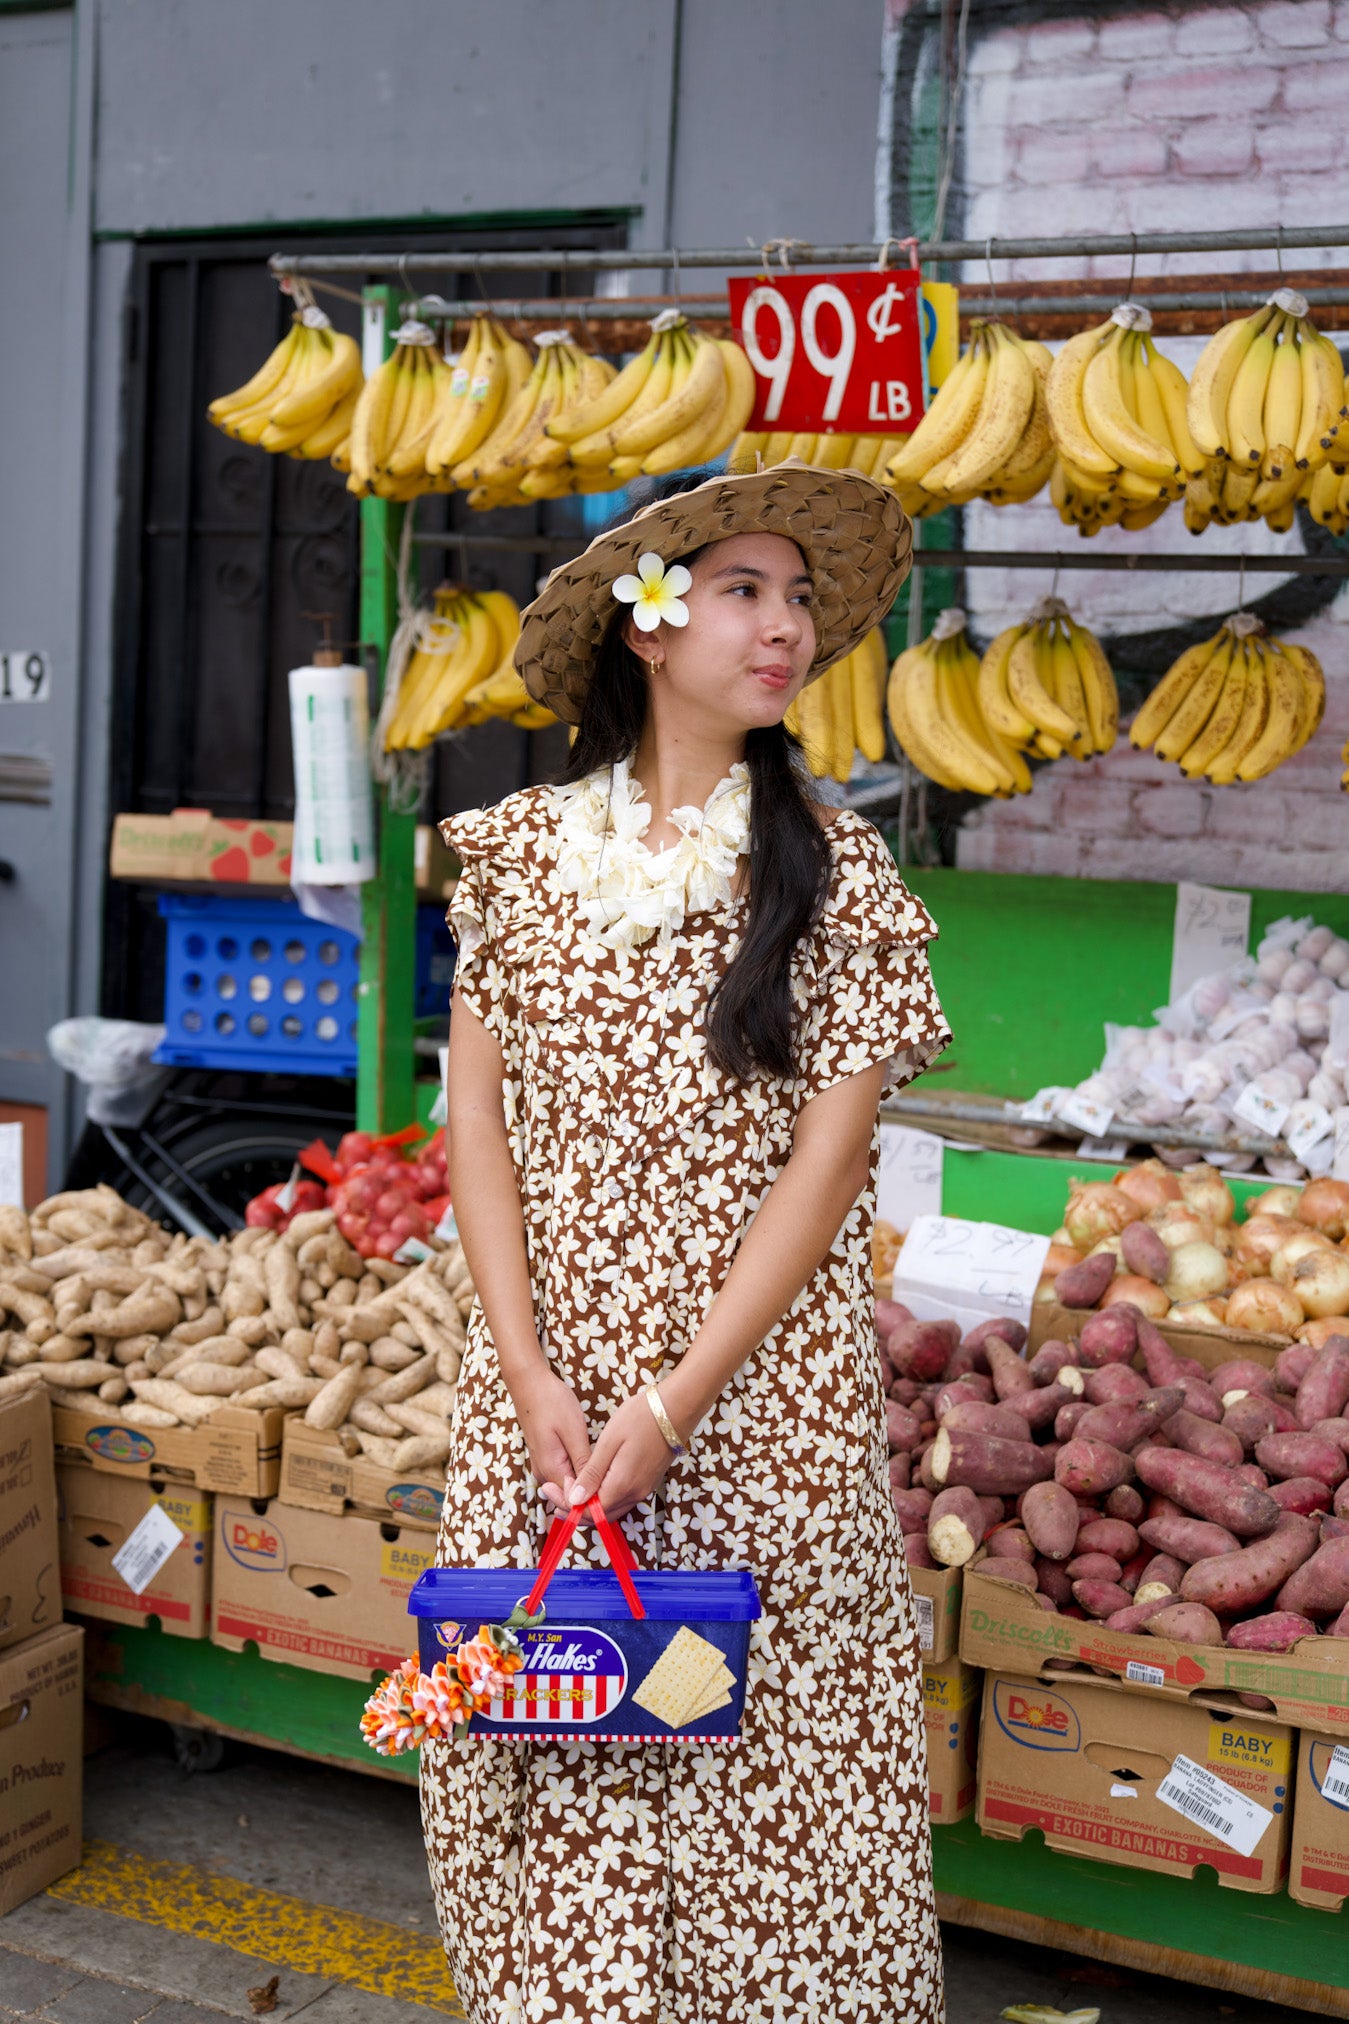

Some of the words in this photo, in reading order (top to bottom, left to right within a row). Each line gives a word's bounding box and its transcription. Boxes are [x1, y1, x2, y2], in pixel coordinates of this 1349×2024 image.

[868, 381, 912, 421] LB
[233, 1524, 278, 1552] Dole
[391, 1549, 432, 1568] BABY
[527, 1633, 545, 1643] M.Y.
[545, 1633, 562, 1643] San
[969, 1609, 1075, 1651] Driscoll's
[266, 1630, 308, 1651] EXOTIC
[309, 1639, 369, 1665] BANANAS
[1092, 1638, 1167, 1661] Strawberries
[924, 1678, 947, 1695] BY
[1008, 1694, 1069, 1730] Dole
[1221, 1732, 1273, 1754] BABY
[1176, 1756, 1191, 1770] Item
[1219, 1748, 1229, 1756] 15
[1231, 1750, 1239, 1759] lb
[1241, 1753, 1257, 1763] (6.8
[1259, 1756, 1274, 1767] kg)
[11, 1757, 66, 1787] Produce
[1206, 1763, 1252, 1780] PRODUCT
[1254, 1773, 1268, 1783] OF
[1017, 1786, 1032, 1795] Dole
[1033, 1790, 1049, 1799] Food
[1221, 1776, 1268, 1793] ECUADOR
[986, 1788, 1029, 1803] DISTRIBUTED
[1040, 1799, 1061, 1811] DOLE
[1063, 1804, 1089, 1816] FRESH
[1090, 1811, 1113, 1822] FRUIT
[1160, 1827, 1200, 1844] CHARLOTTE
[1053, 1816, 1108, 1843] EXOTIC
[1111, 1828, 1189, 1861] BANANAS
[1302, 1854, 1349, 1870] DISTRIBUTED
